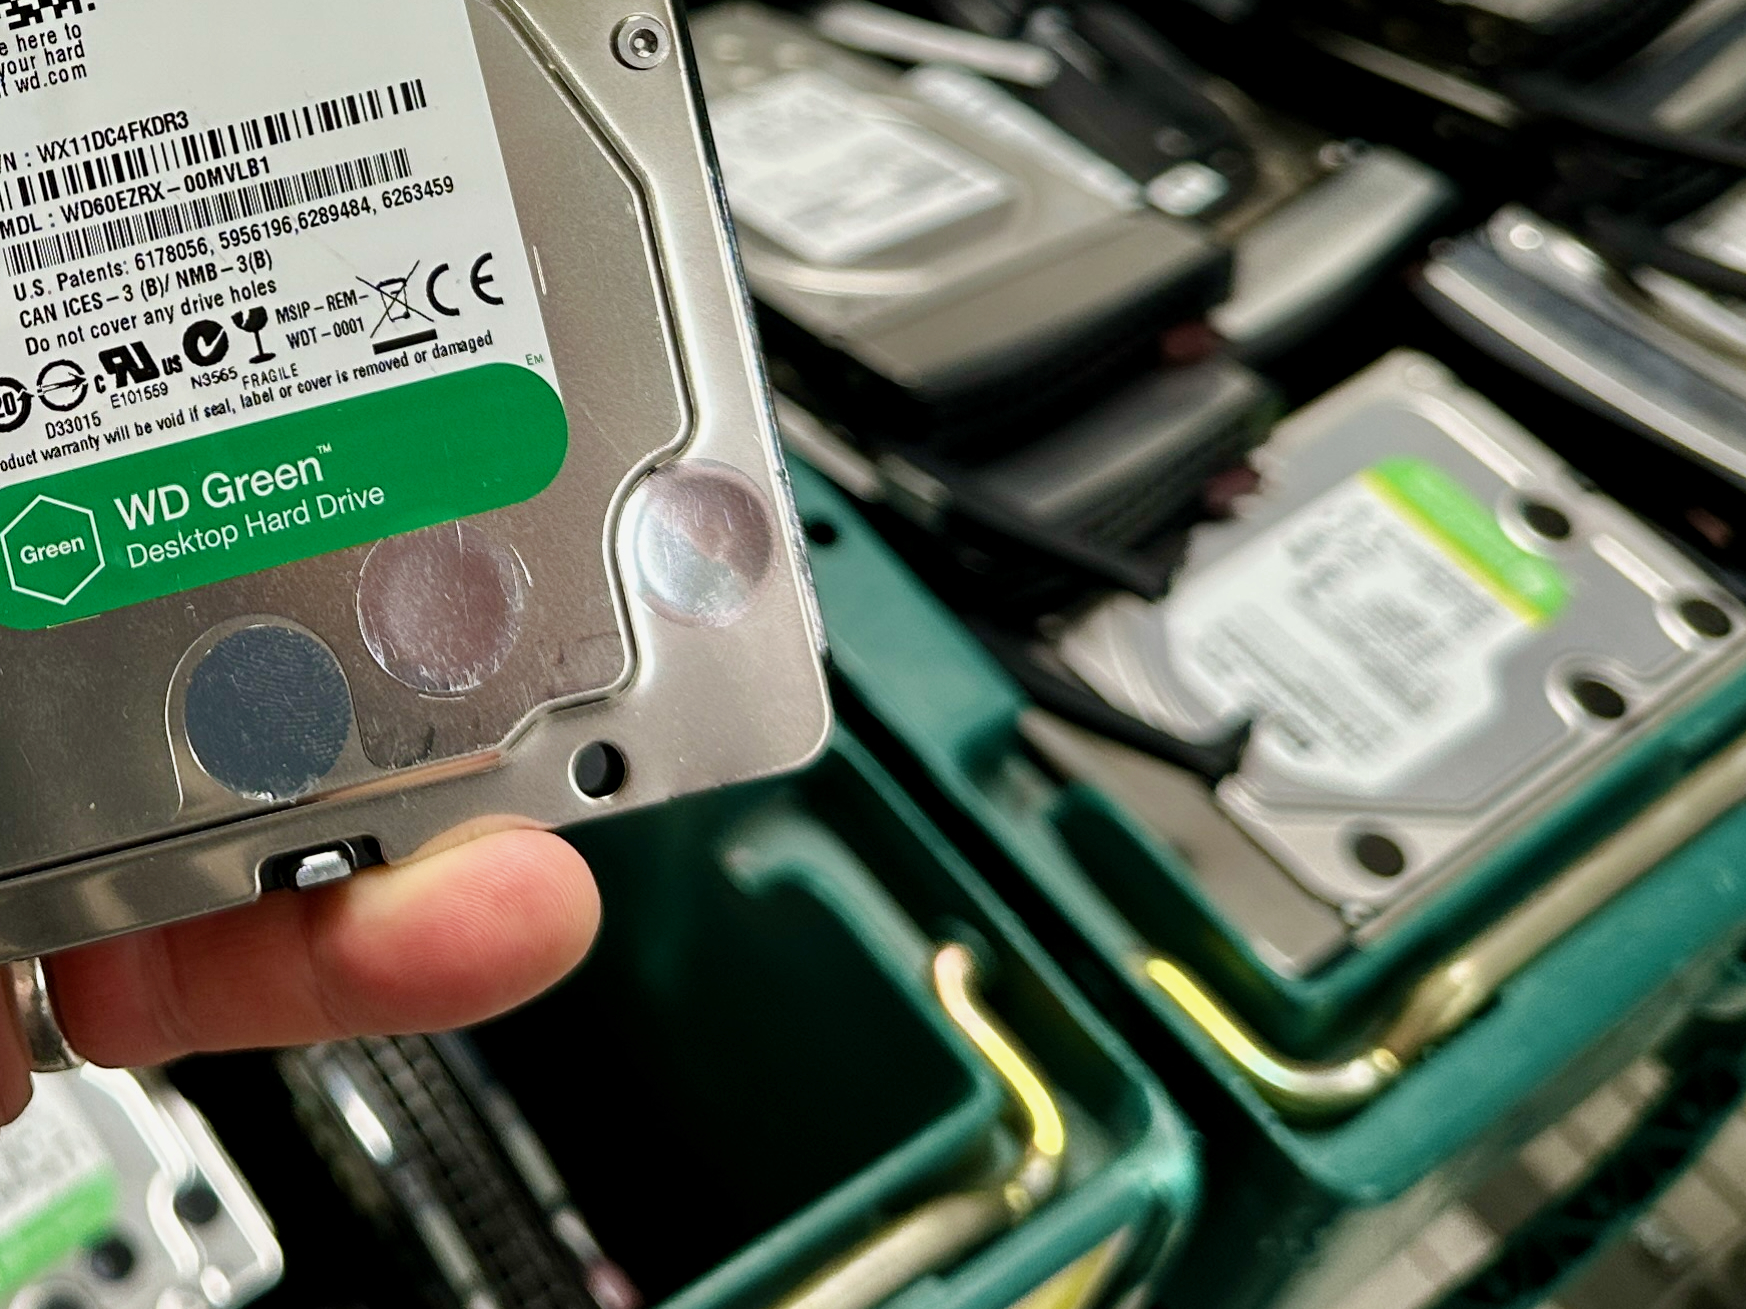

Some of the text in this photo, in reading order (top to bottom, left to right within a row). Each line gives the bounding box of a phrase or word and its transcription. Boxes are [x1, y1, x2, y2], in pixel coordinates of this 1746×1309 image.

[15, 29, 58, 53] here
[64, 22, 82, 41] to
[43, 38, 86, 67] hard
[13, 63, 88, 94] wd.com
[35, 110, 190, 164] WX11DC4FKDR3
[12, 278, 52, 302] U.S.
[56, 260, 129, 292] Patents:
[134, 236, 215, 272] 6178056,
[381, 175, 454, 209] 6263459
[19, 302, 58, 329] CAN
[24, 279, 278, 357] Do not cover any drive holes
[190, 365, 239, 390] N3565
[241, 362, 299, 391] FRAGILE
[39, 433, 100, 462] warranty
[102, 424, 131, 445] will
[133, 421, 153, 437] be
[155, 408, 186, 431] void
[188, 404, 200, 423] if
[203, 397, 237, 419] seal,
[239, 386, 275, 410] label
[278, 384, 293, 399] or
[296, 374, 333, 394] cover
[335, 369, 349, 385] is
[352, 350, 410, 380] removed
[413, 350, 428, 364] or
[431, 329, 494, 360] damaged
[44, 410, 102, 440] D33015
[113, 484, 190, 531] WD
[126, 486, 385, 569] Desktop Hard Drive
[20, 537, 86, 565] Green
